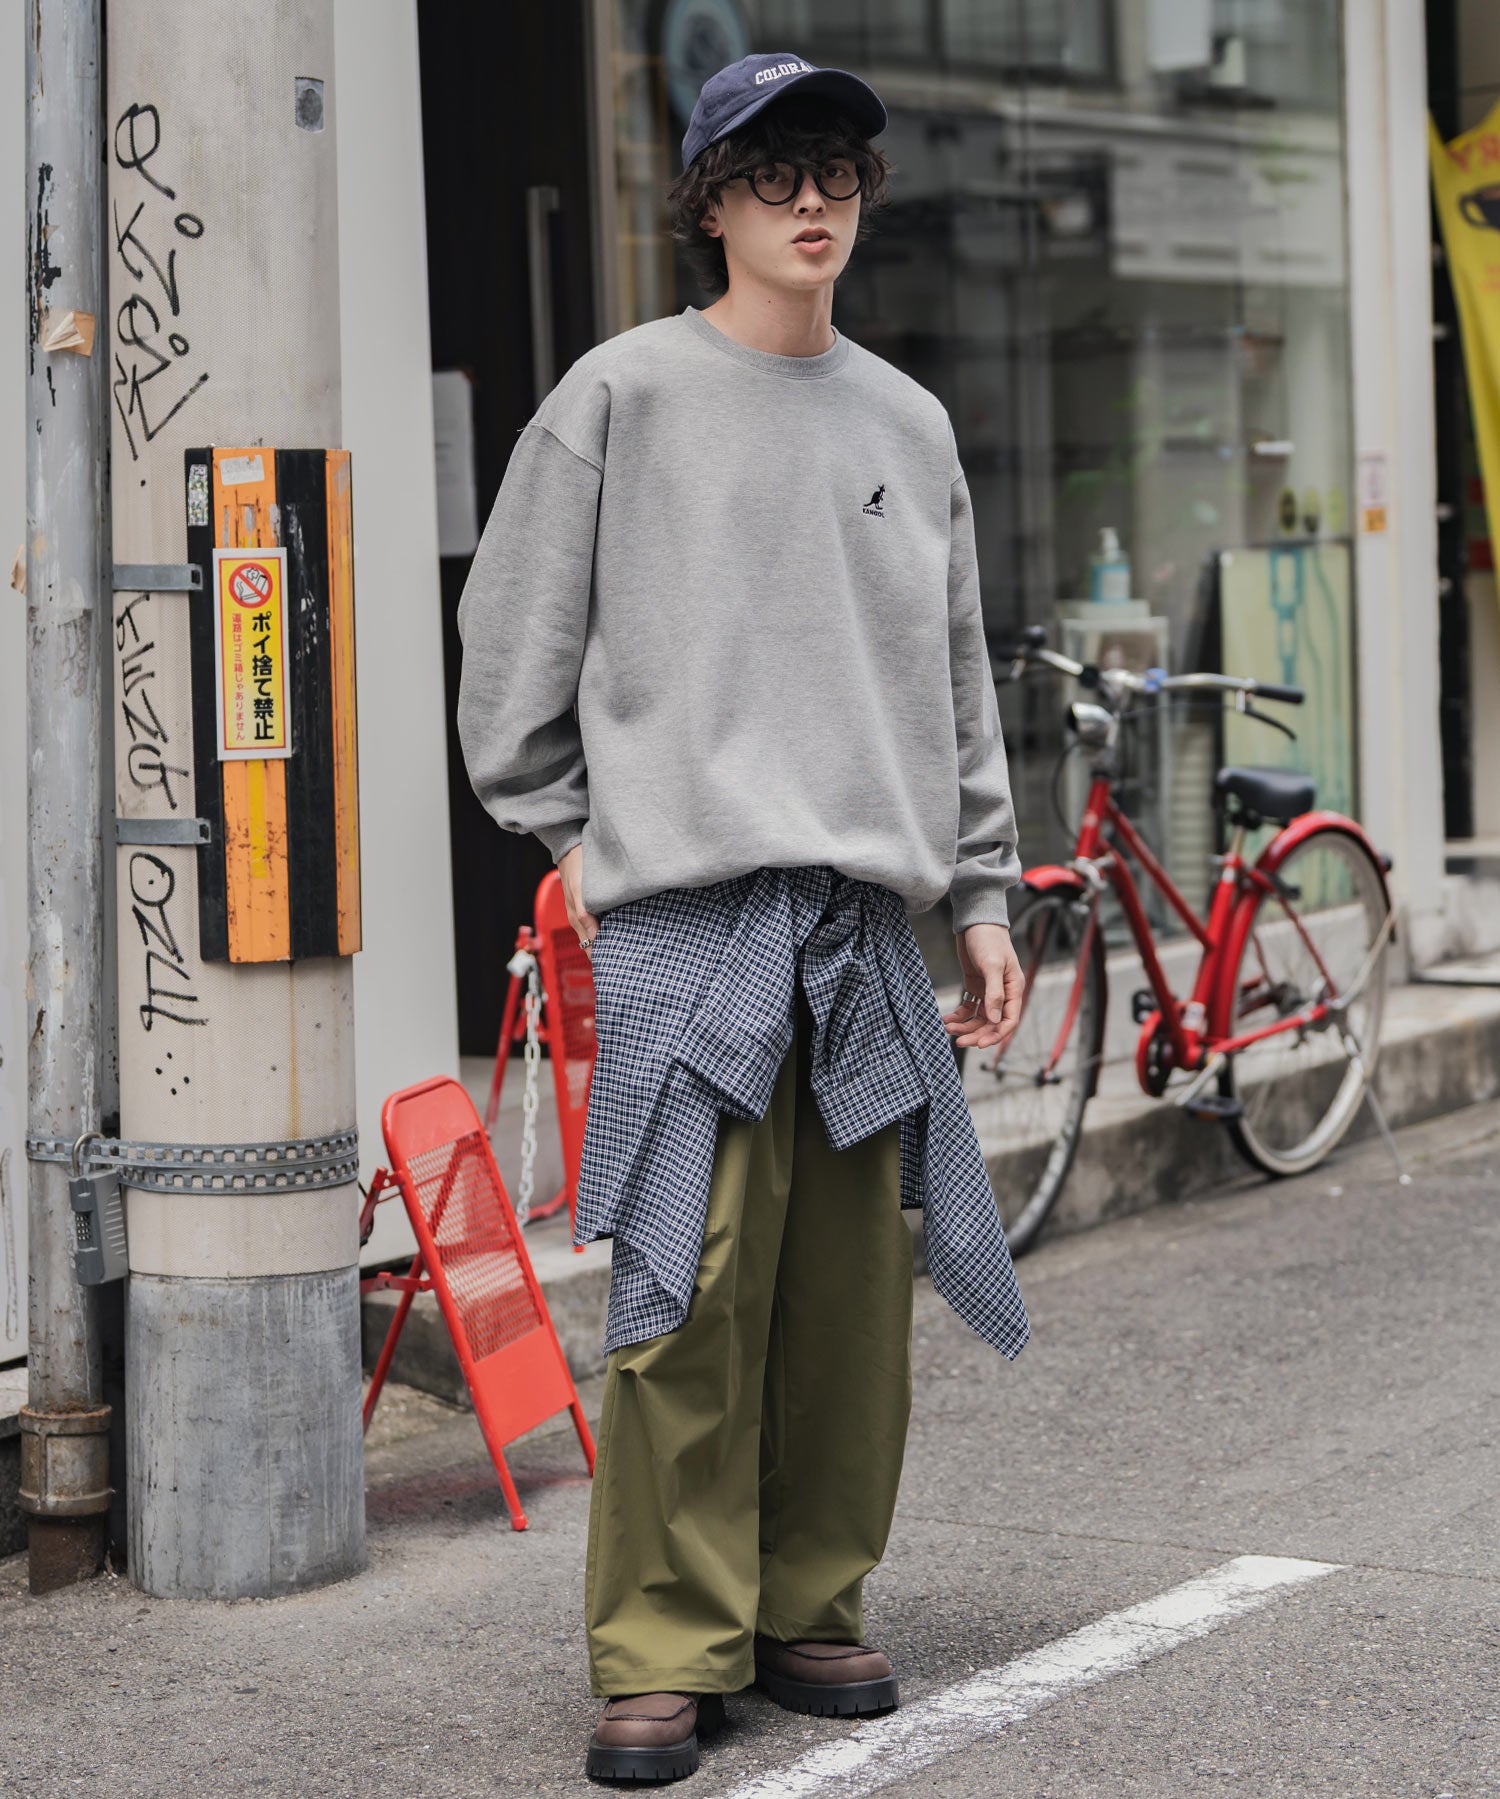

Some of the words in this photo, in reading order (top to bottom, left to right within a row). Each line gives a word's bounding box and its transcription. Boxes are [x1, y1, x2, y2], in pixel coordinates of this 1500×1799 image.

[862, 508, 885, 518] KANGOL
[232, 613, 245, 741] 道路はゴミ箱じゃありません
[252, 611, 274, 740] ポイ捨て禁止
